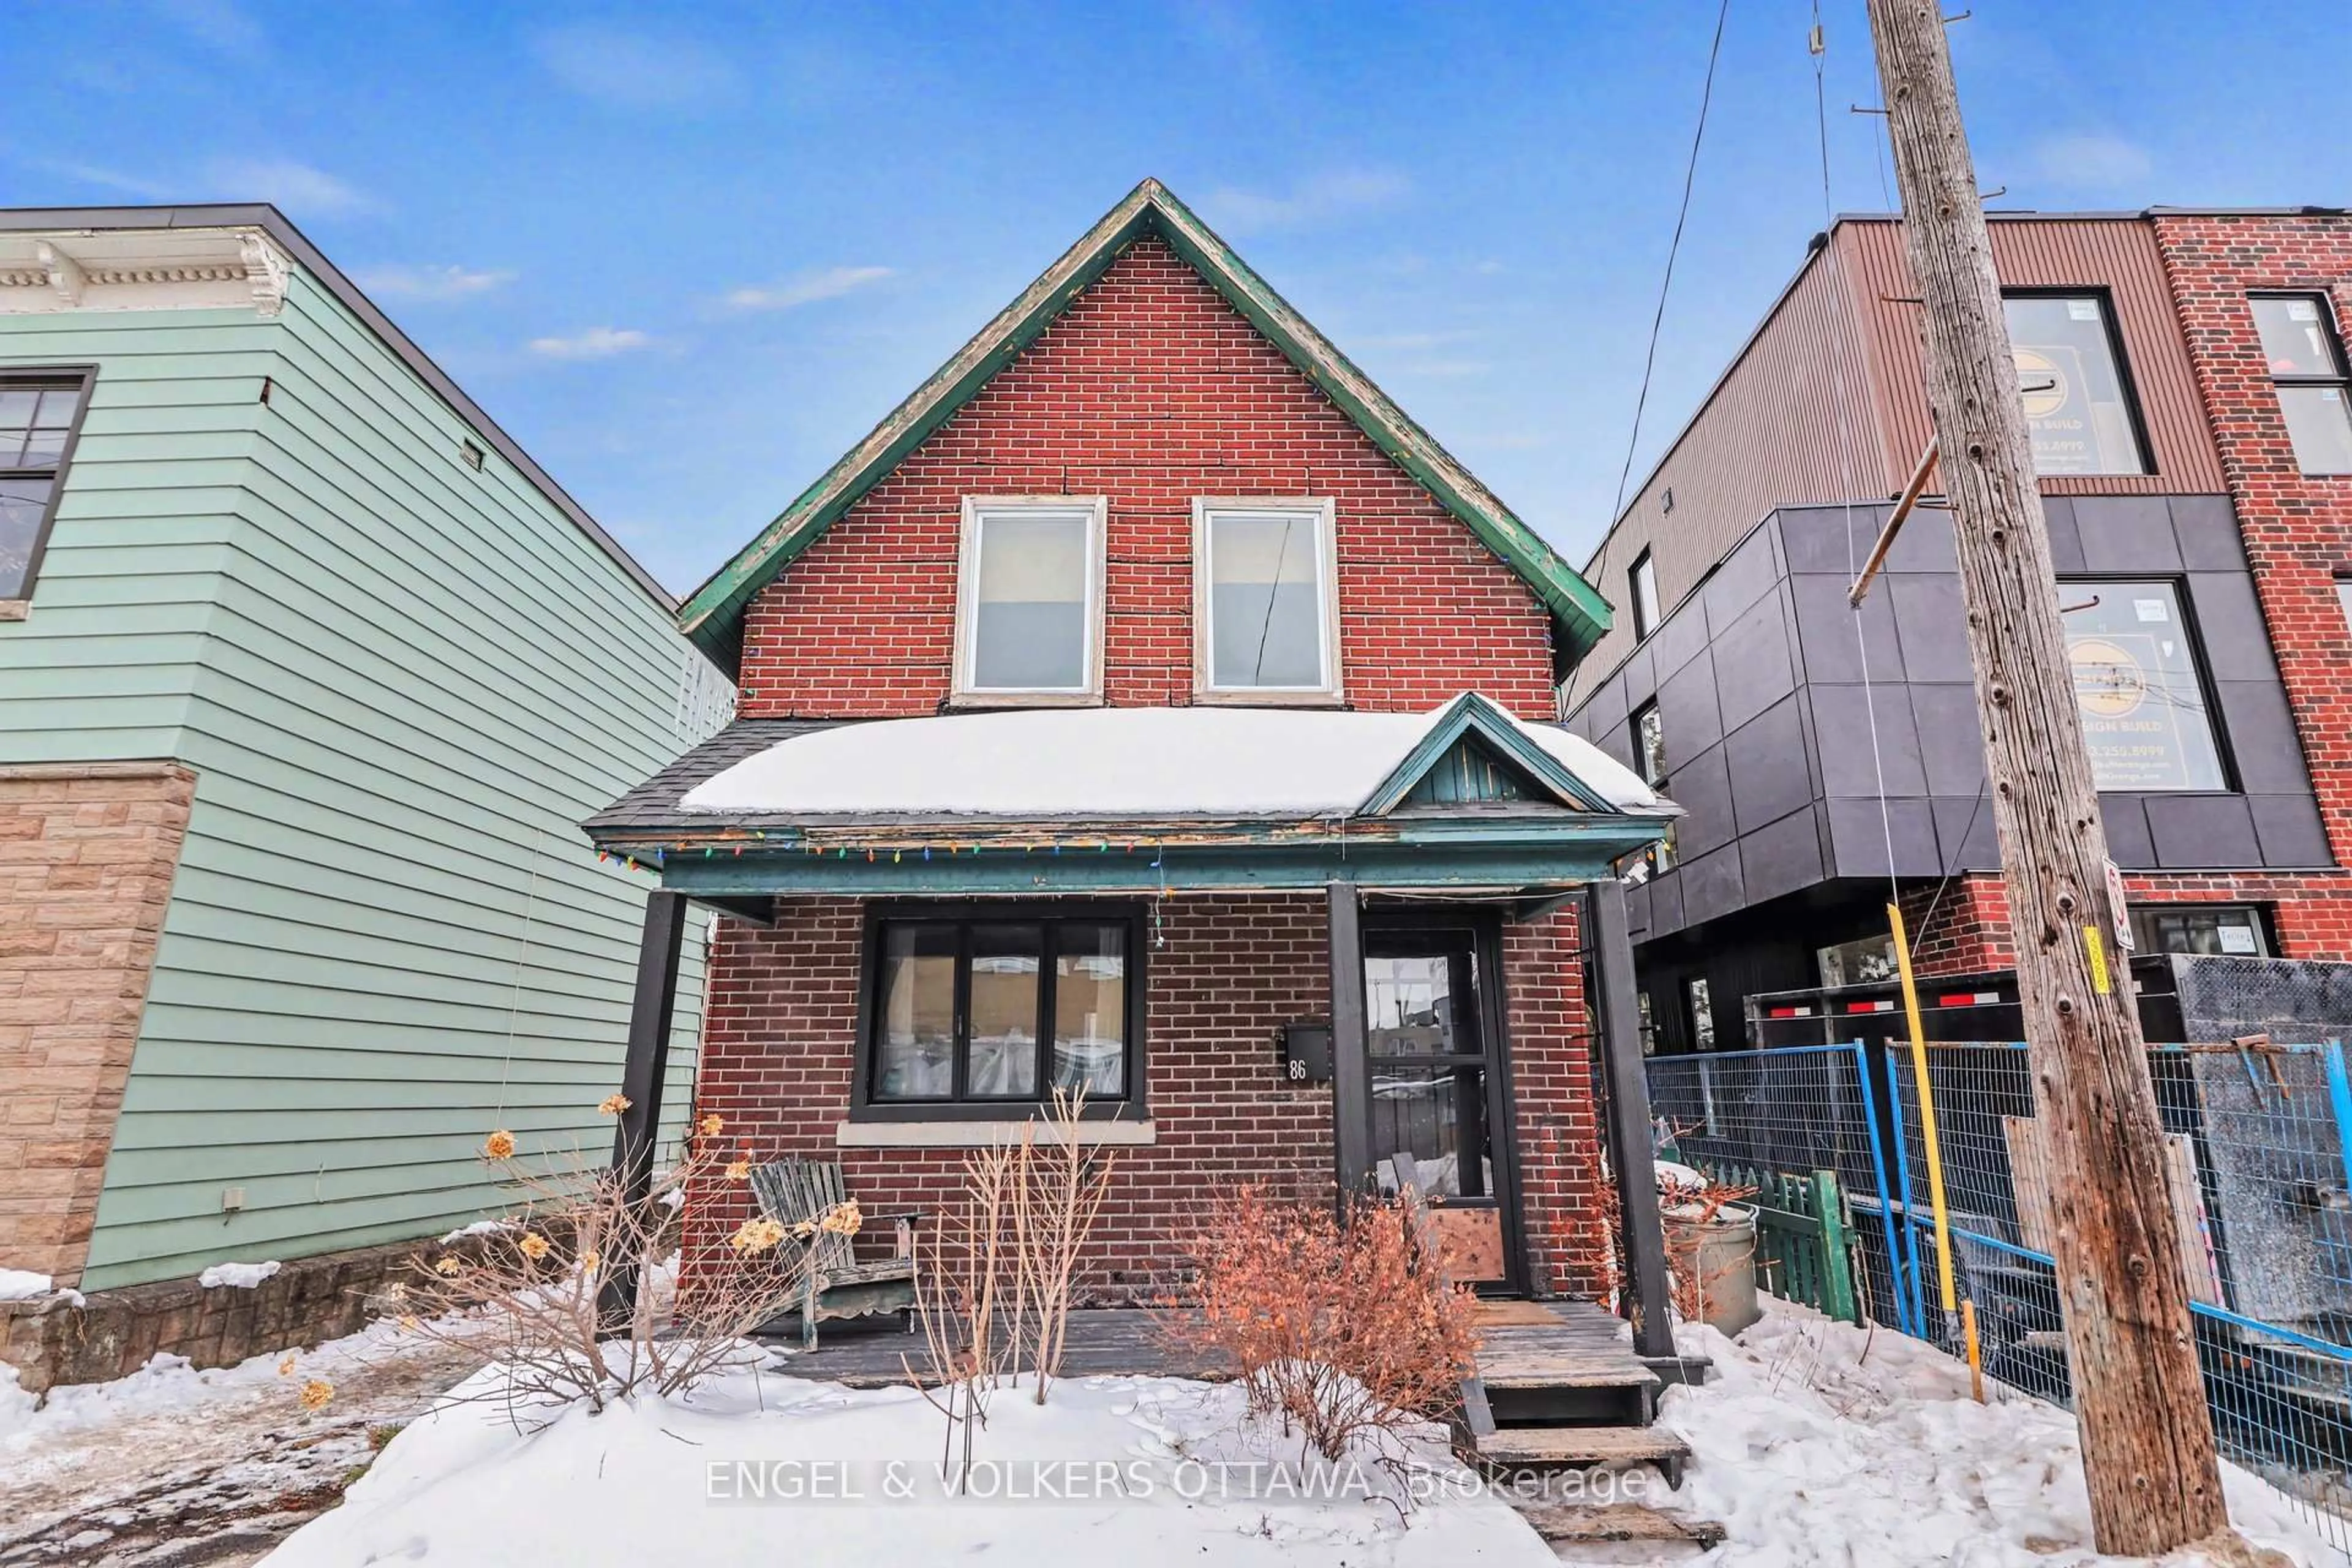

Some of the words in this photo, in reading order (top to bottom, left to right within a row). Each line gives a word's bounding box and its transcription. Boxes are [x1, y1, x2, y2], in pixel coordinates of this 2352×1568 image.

[2082, 720, 2117, 733] SIGN
[2120, 720, 2162, 733] BUILD
[1290, 1060, 1306, 1079] 86
